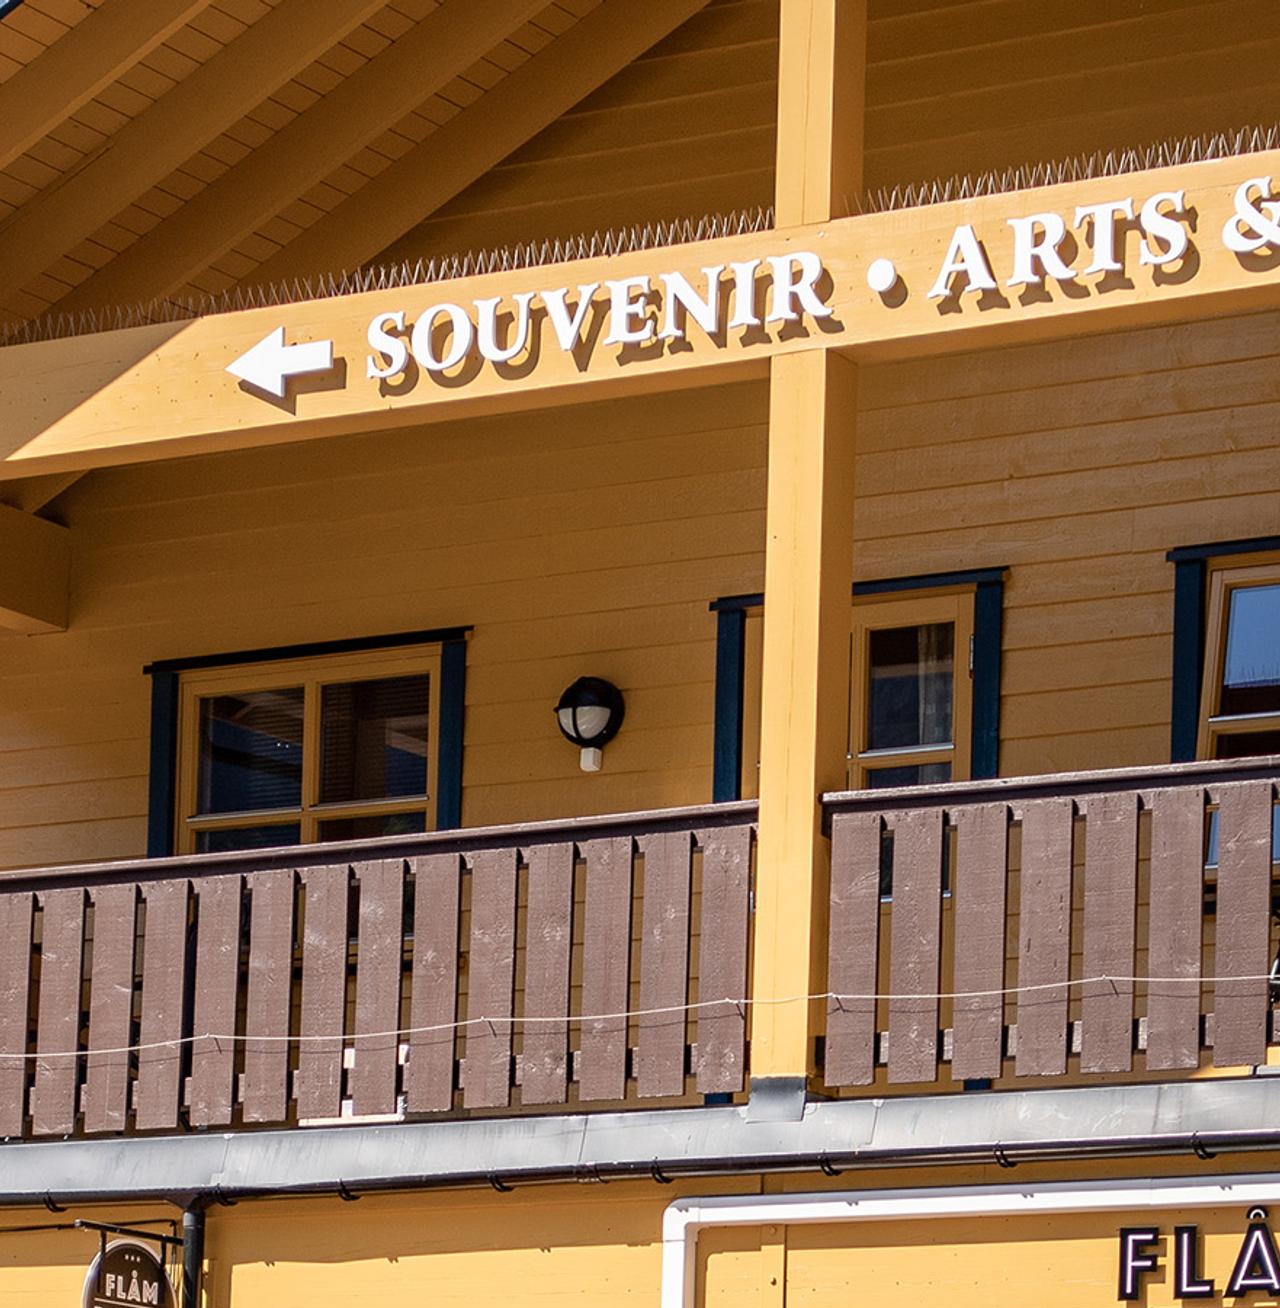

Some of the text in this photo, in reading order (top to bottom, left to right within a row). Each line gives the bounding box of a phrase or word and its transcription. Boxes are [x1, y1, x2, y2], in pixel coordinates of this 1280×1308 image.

[366, 250, 834, 380] SOUVENIR
[926, 189, 1189, 301] ARTS
[104, 1269, 159, 1305] FLÅM
